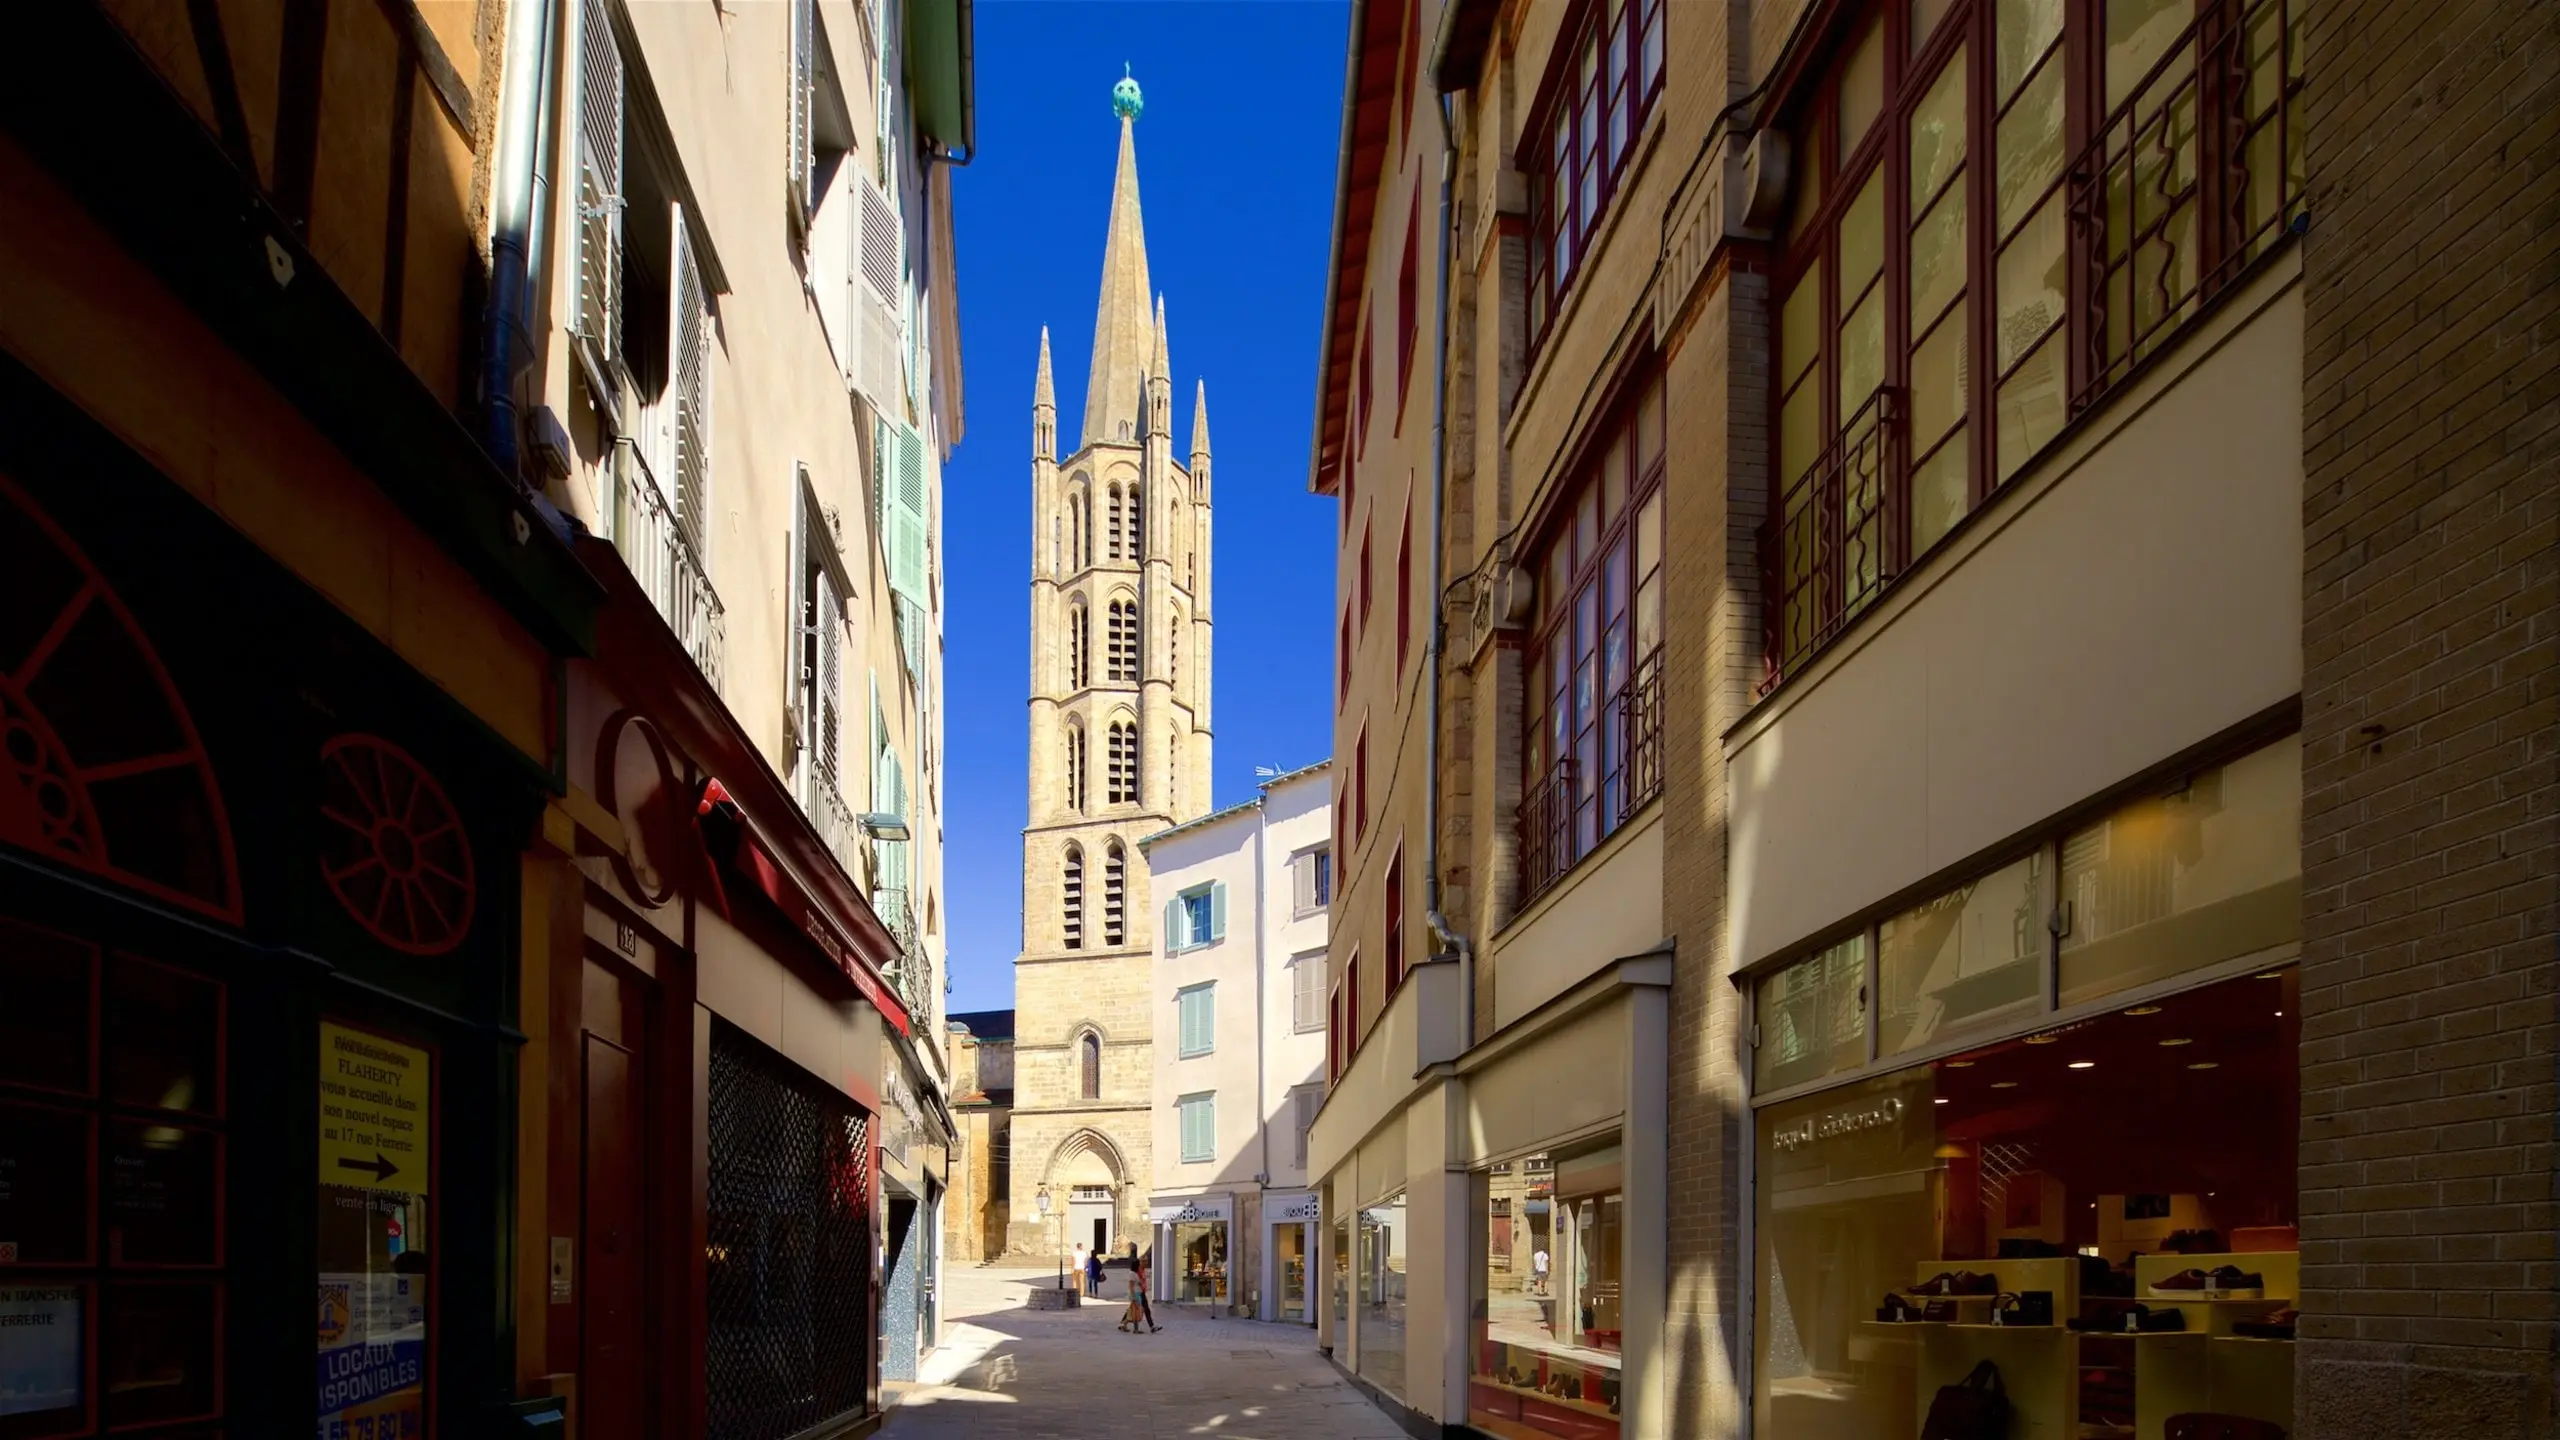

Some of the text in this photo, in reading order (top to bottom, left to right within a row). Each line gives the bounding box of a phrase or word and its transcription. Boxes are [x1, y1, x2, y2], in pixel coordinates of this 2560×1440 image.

[339, 1058, 403, 1086] FLAHERTY
[319, 1081, 417, 1111] vous accueille dans
[324, 1105, 414, 1132] son nouvel espace
[324, 1126, 414, 1152] au 17 rue Ferrerie
[335, 1195, 363, 1210] vente
[0, 1312, 56, 1327] ERRERIE
[328, 1340, 396, 1381] LOCAUX
